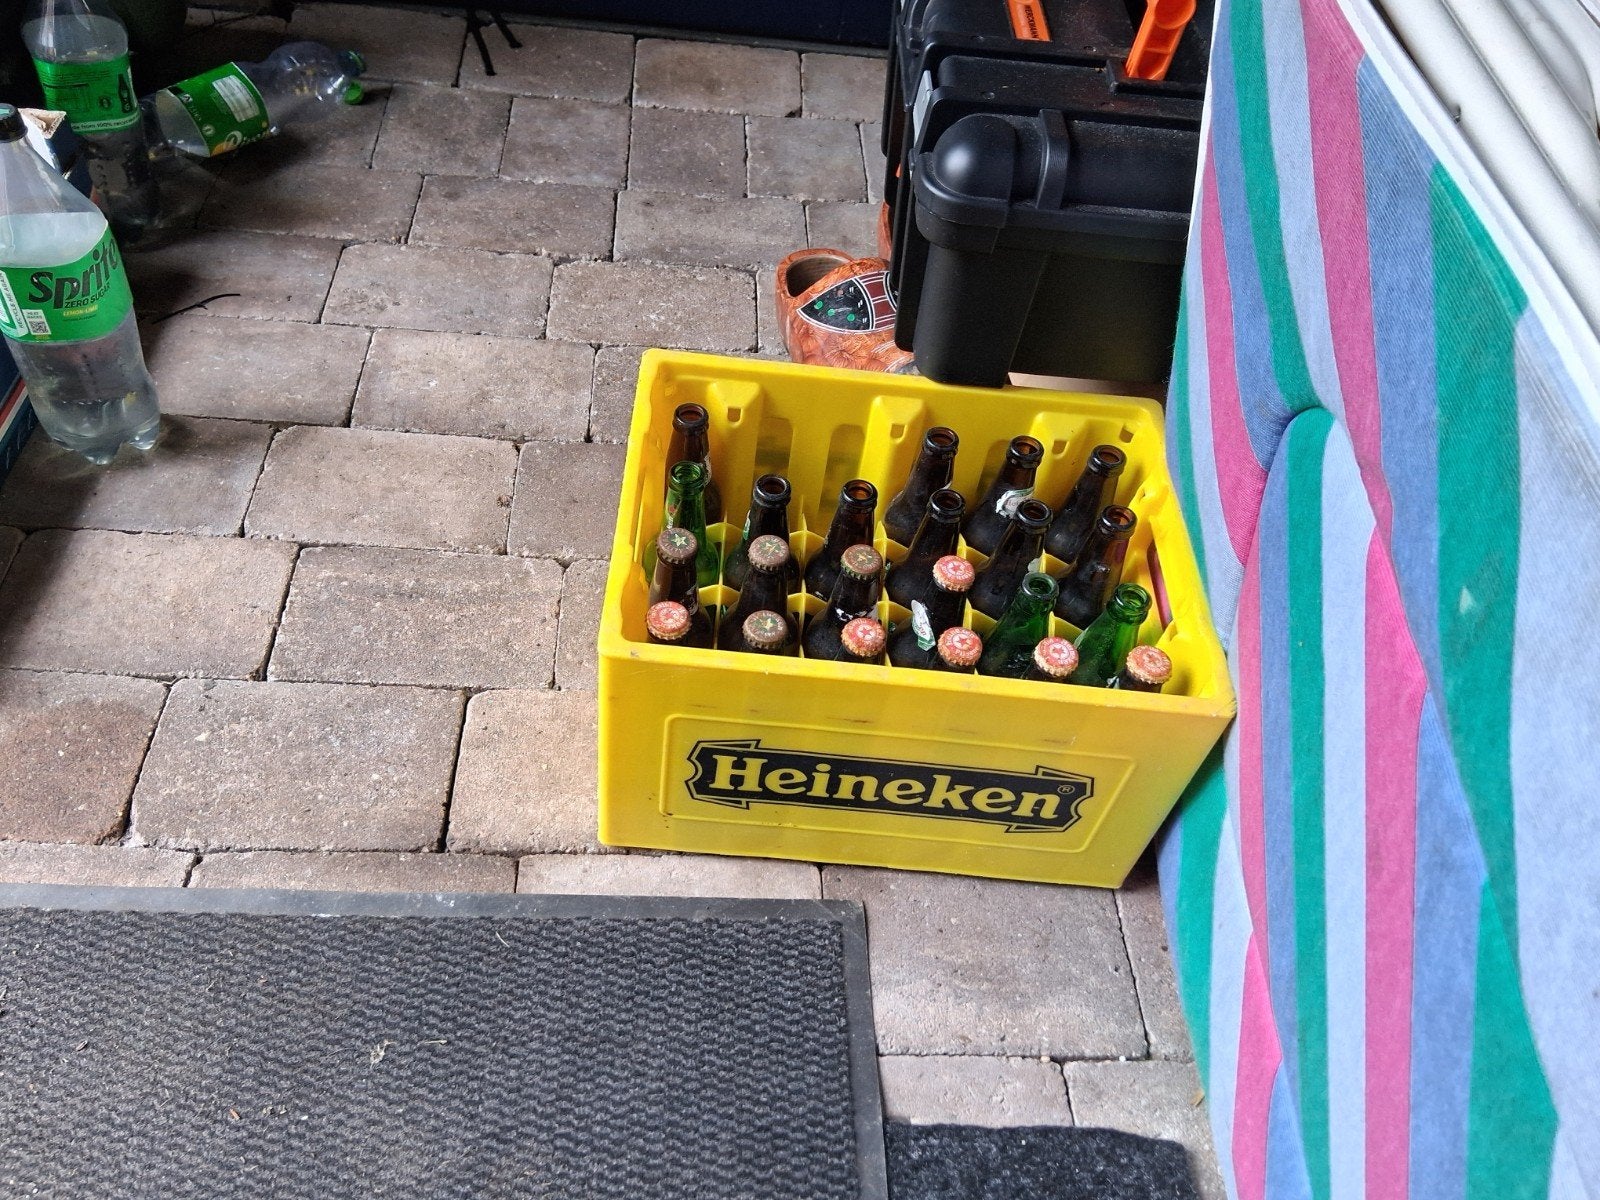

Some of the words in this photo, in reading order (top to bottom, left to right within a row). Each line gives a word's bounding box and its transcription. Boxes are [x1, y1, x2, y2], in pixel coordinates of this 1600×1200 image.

[28, 238, 119, 309] Sprite
[64, 299, 89, 308] ZERO
[708, 754, 1060, 820] Heineken
